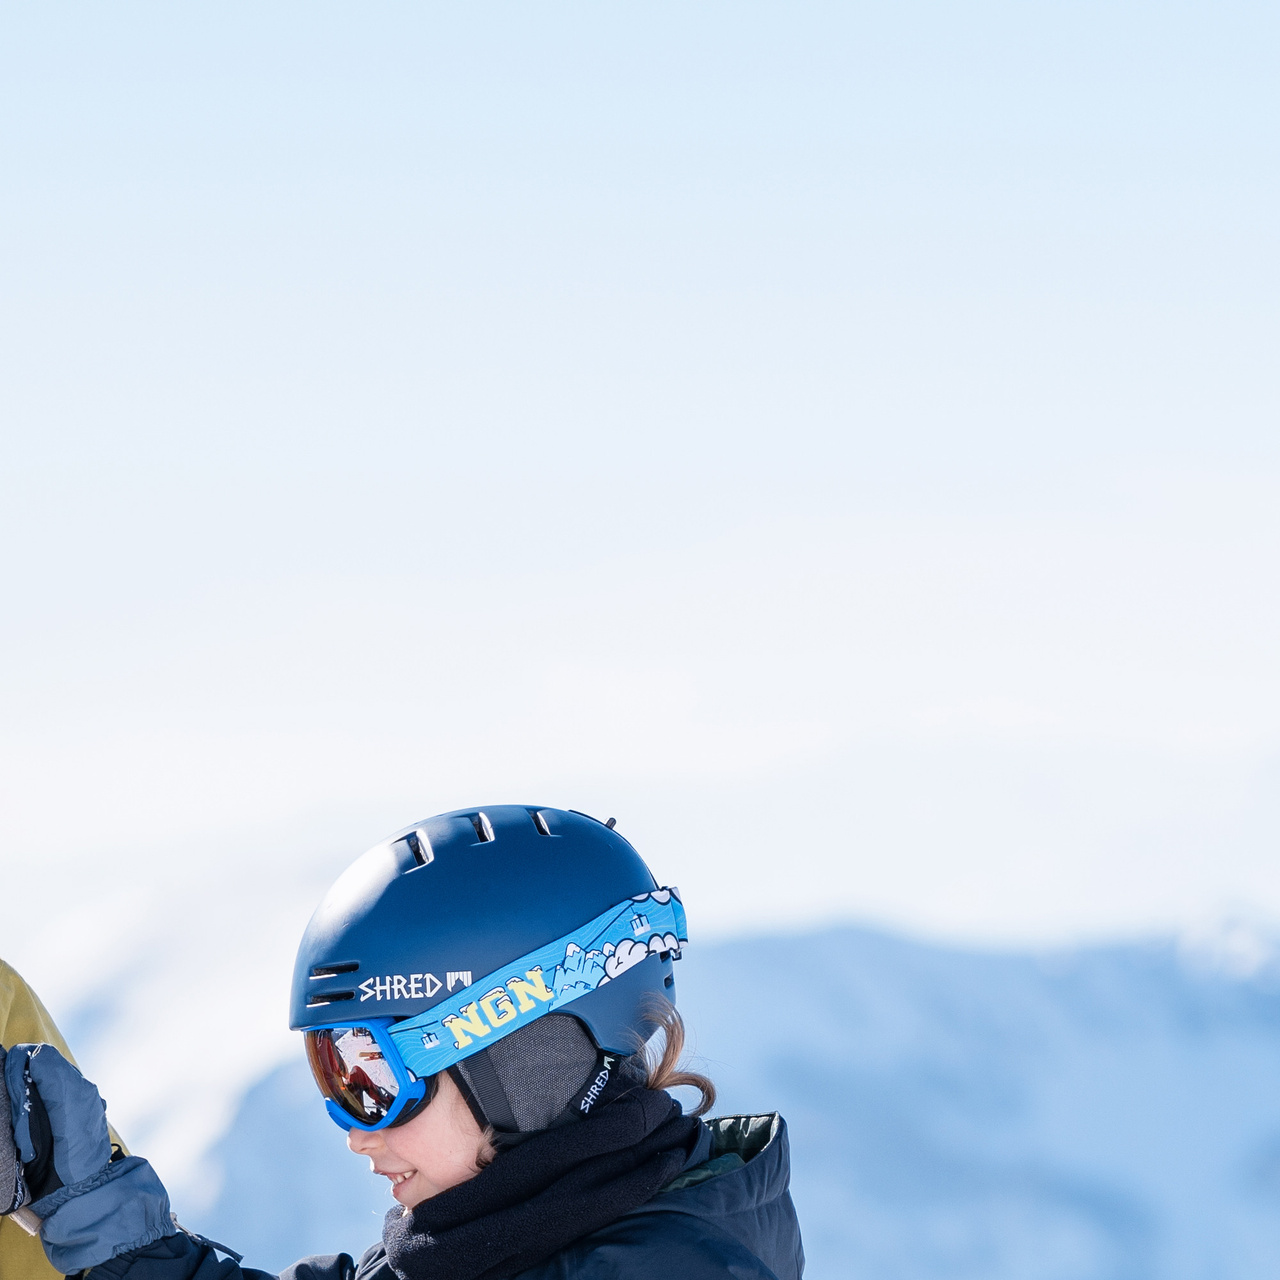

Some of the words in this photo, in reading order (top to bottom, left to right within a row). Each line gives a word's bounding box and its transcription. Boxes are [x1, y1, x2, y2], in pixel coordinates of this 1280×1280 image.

[358, 973, 443, 1002] SHRED
[441, 965, 555, 1049] NGN
[580, 1069, 609, 1113] SHRED
